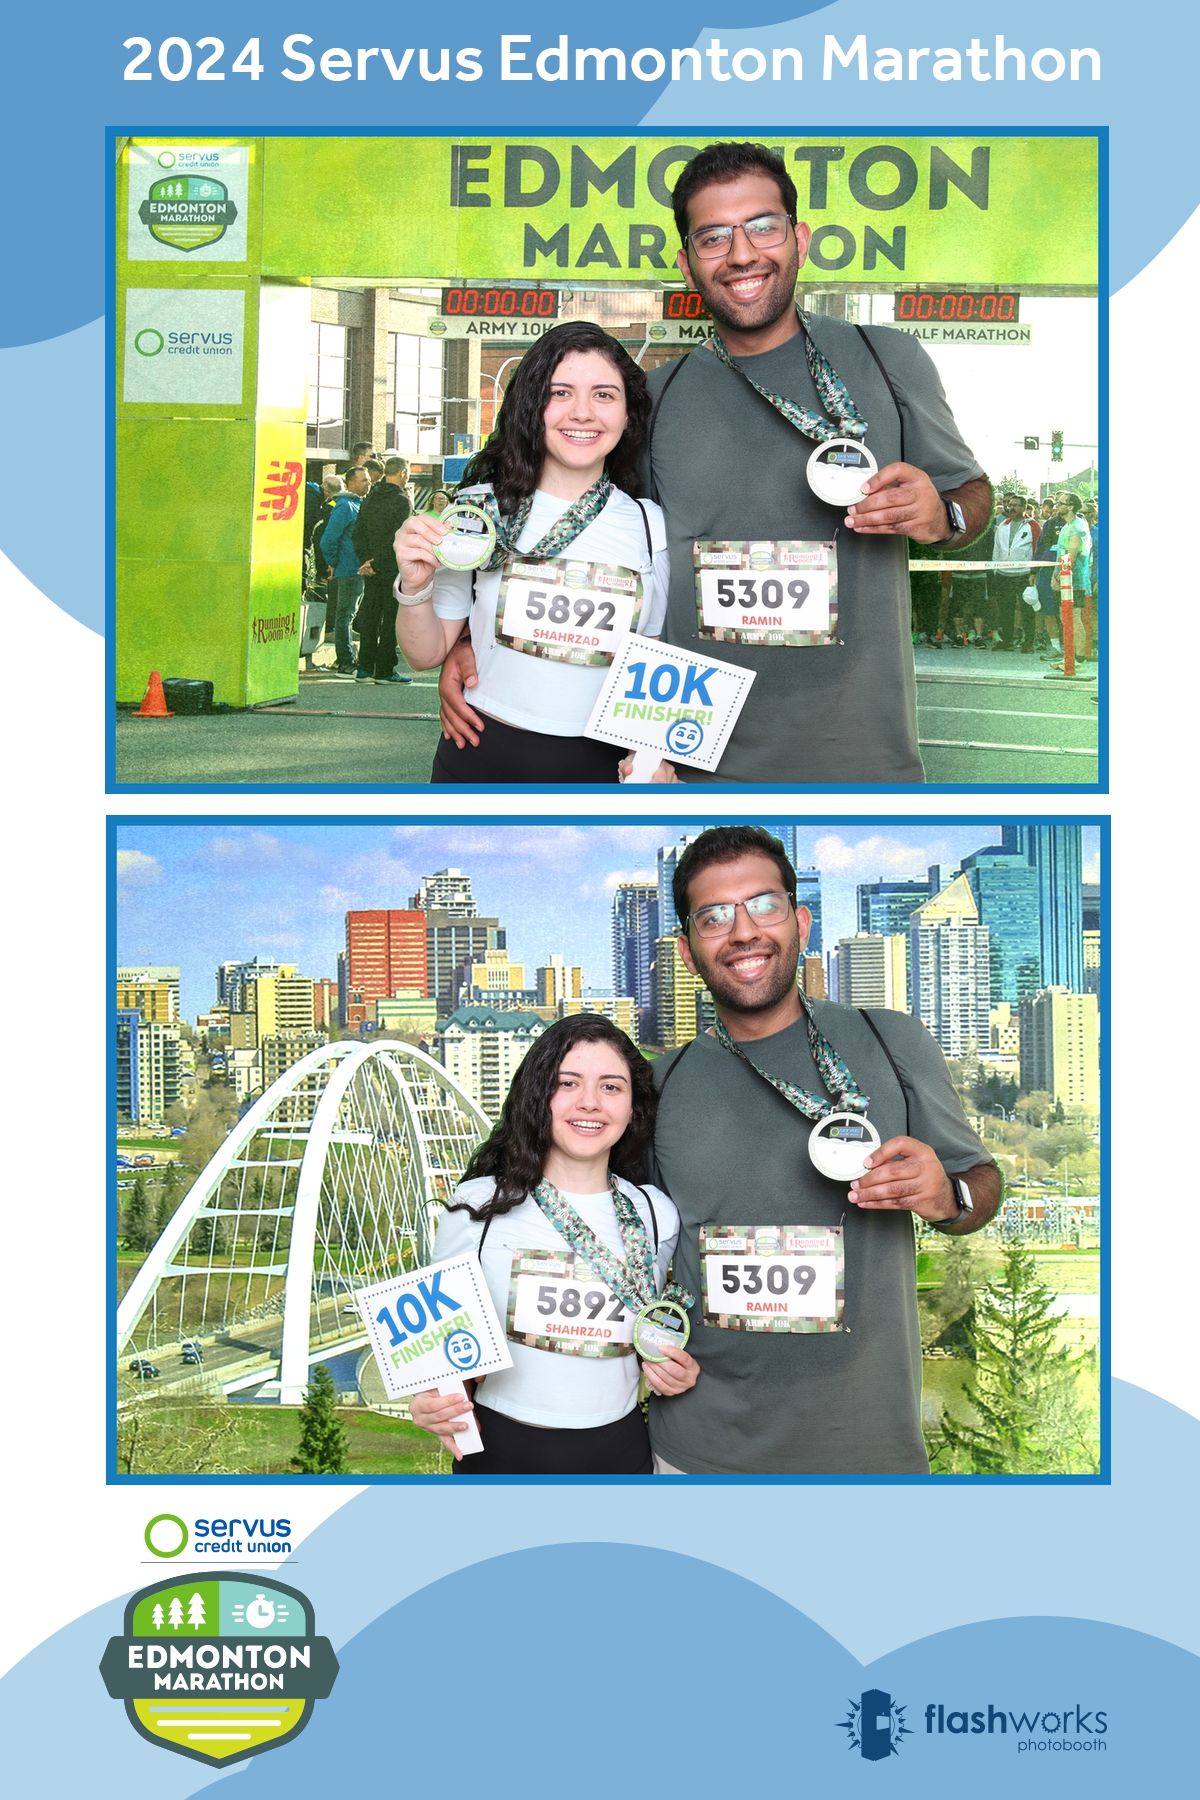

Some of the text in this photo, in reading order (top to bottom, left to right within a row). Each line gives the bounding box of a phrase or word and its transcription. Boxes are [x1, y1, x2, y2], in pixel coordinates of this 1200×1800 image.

[178, 152, 219, 162] servus
[450, 145, 990, 211] EDMOTON
[150, 202, 226, 214] EDMONTON
[160, 214, 216, 223] MARATHON
[523, 222, 906, 271] MARON
[466, 321, 518, 335] ARMY
[901, 328, 1031, 341] HALF MARATHON
[168, 331, 233, 345] servus
[168, 344, 233, 355] credit union
[717, 579, 810, 609] 5309
[525, 590, 616, 632] 5892
[742, 615, 782, 626] RAMIN
[532, 628, 600, 646] SHAHRZAD
[741, 632, 785, 641] ARMY 10K
[542, 647, 587, 660] ARMY 10K
[624, 662, 719, 707] 10K
[613, 702, 714, 726] FINISHER!
[722, 1264, 816, 1295] 5309
[376, 1269, 462, 1348] 10K
[537, 1285, 625, 1323] 5892
[747, 1302, 788, 1312] RAMIN
[745, 1319, 790, 1328] ARMY 10K
[545, 1323, 612, 1339] SHAHRZAD
[390, 1311, 474, 1370] FINISHER!
[555, 1341, 600, 1353] ARMY 10K
